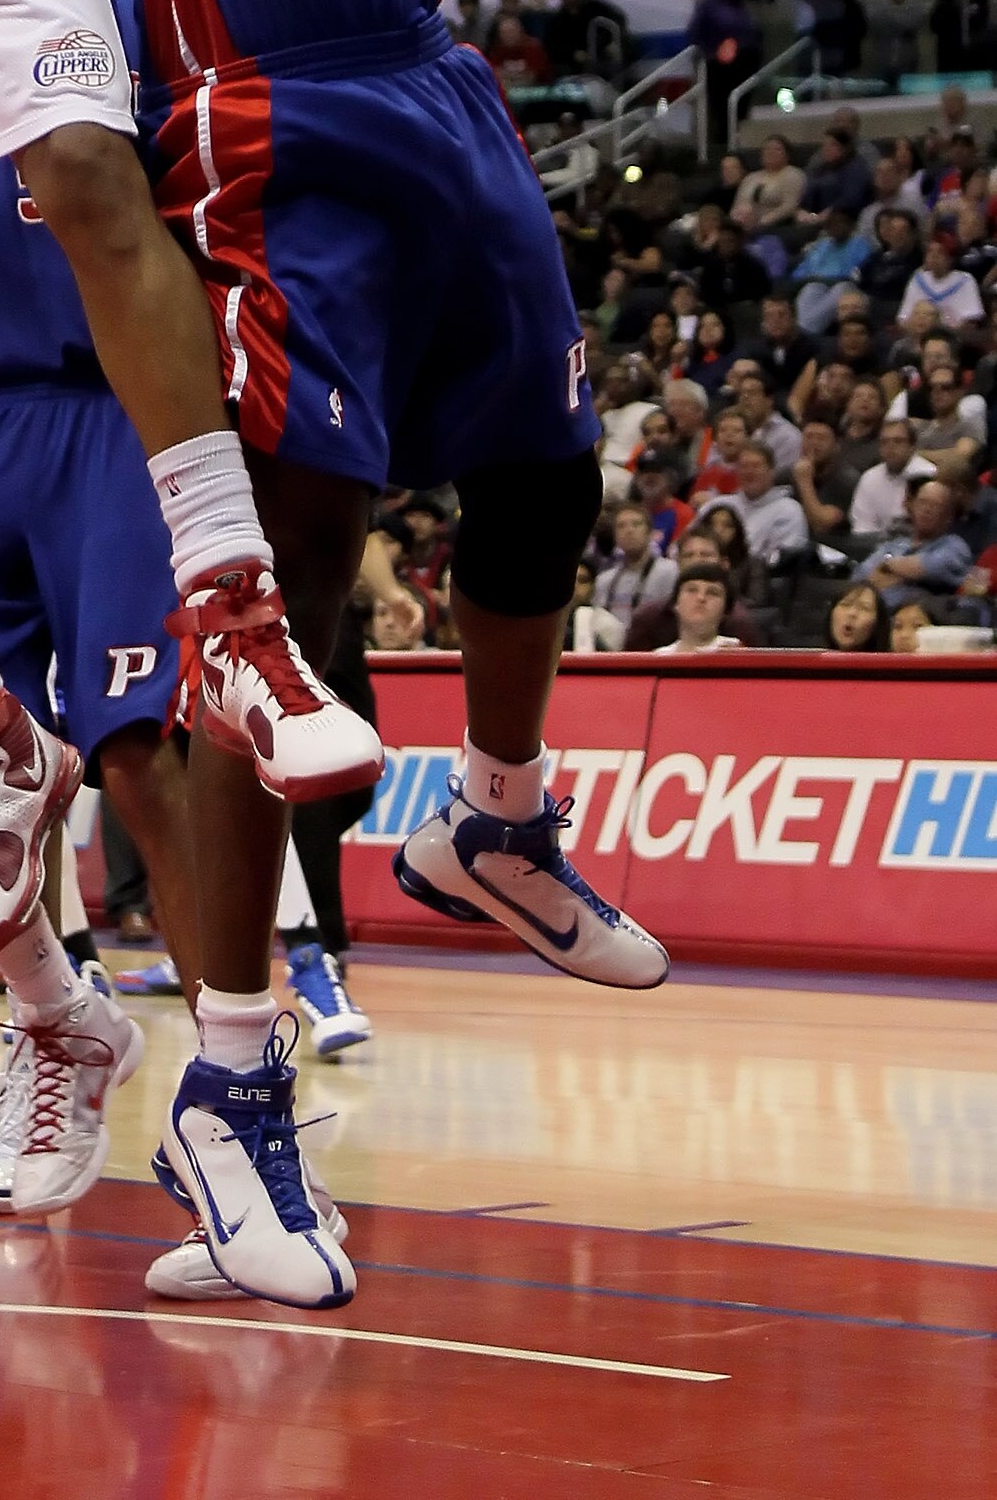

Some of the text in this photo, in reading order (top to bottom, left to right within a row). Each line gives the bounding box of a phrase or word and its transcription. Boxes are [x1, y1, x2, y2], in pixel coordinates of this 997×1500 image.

[32, 54, 110, 87] CLIPPERS
[566, 338, 587, 411] P
[106, 645, 158, 698] P
[554, 748, 904, 867] TICKET
[227, 1085, 272, 1102] ELITE
